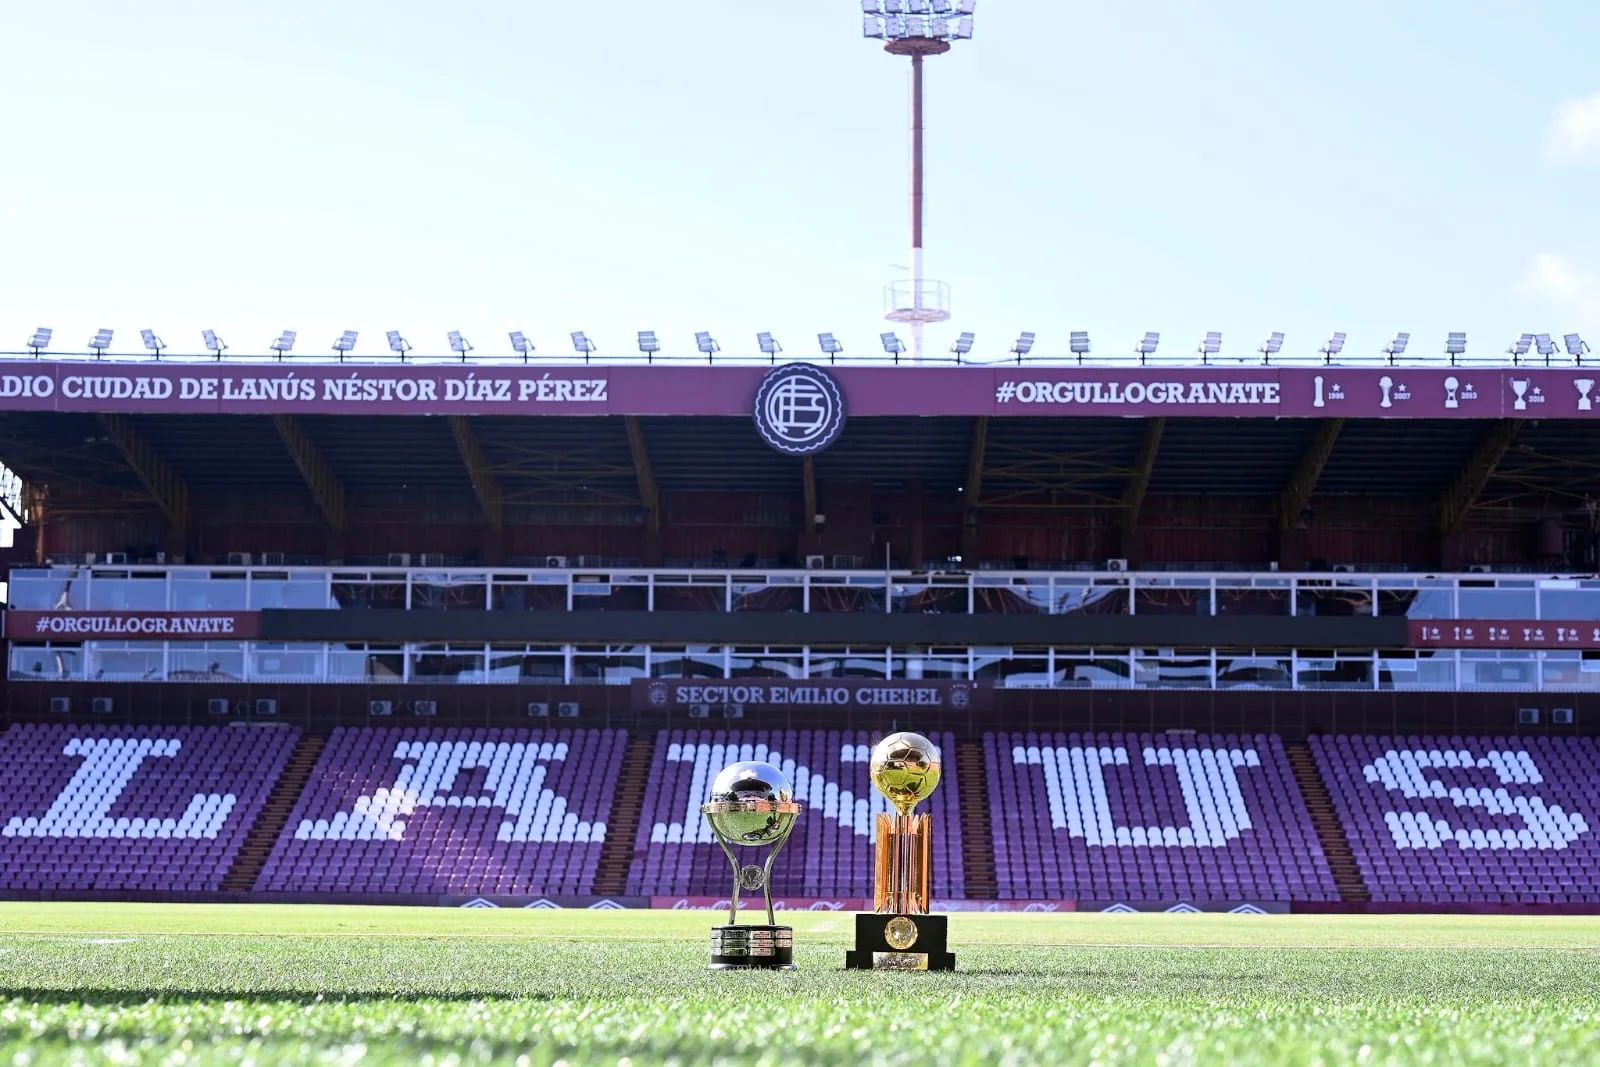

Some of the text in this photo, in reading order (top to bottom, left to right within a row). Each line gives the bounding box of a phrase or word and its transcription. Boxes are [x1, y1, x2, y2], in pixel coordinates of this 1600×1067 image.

[0, 372, 607, 401] DIO CIUDAD DE LANÚS NÉSTOR DÍAZ PÉREZ
[995, 381, 1280, 404] #ORGULLOGRANATE
[35, 616, 234, 633] #ORGULLOGRANATE
[675, 686, 765, 703] SECTOR
[769, 687, 849, 704] EMILIO
